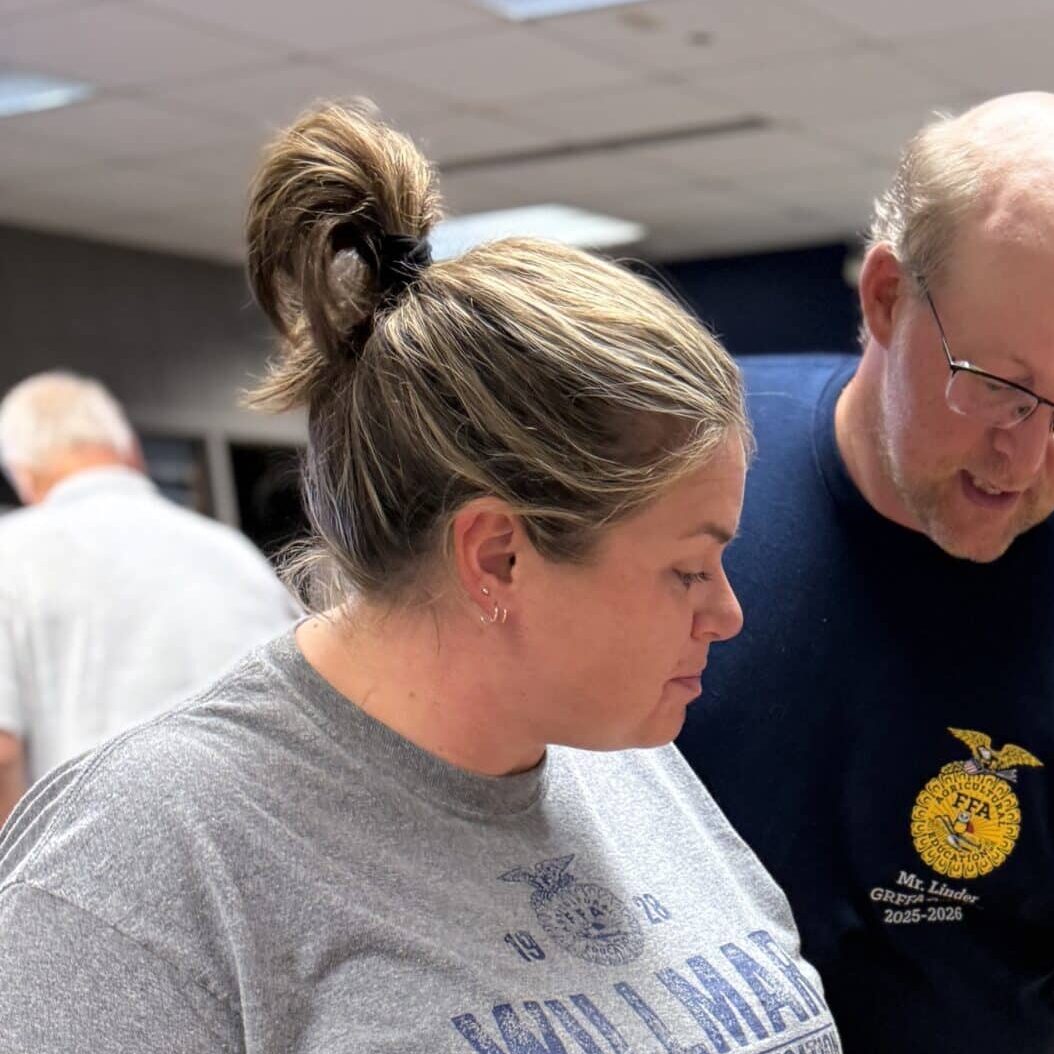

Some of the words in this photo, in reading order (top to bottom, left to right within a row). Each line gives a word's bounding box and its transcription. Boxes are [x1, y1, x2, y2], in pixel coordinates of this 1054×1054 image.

[952, 792, 991, 821] FFA
[928, 831, 989, 863] EDUCATION
[896, 870, 925, 892] Mr.
[928, 879, 980, 903] Linder
[504, 930, 546, 963] 19
[632, 893, 672, 925] 28
[884, 906, 963, 924] 2025-2026
